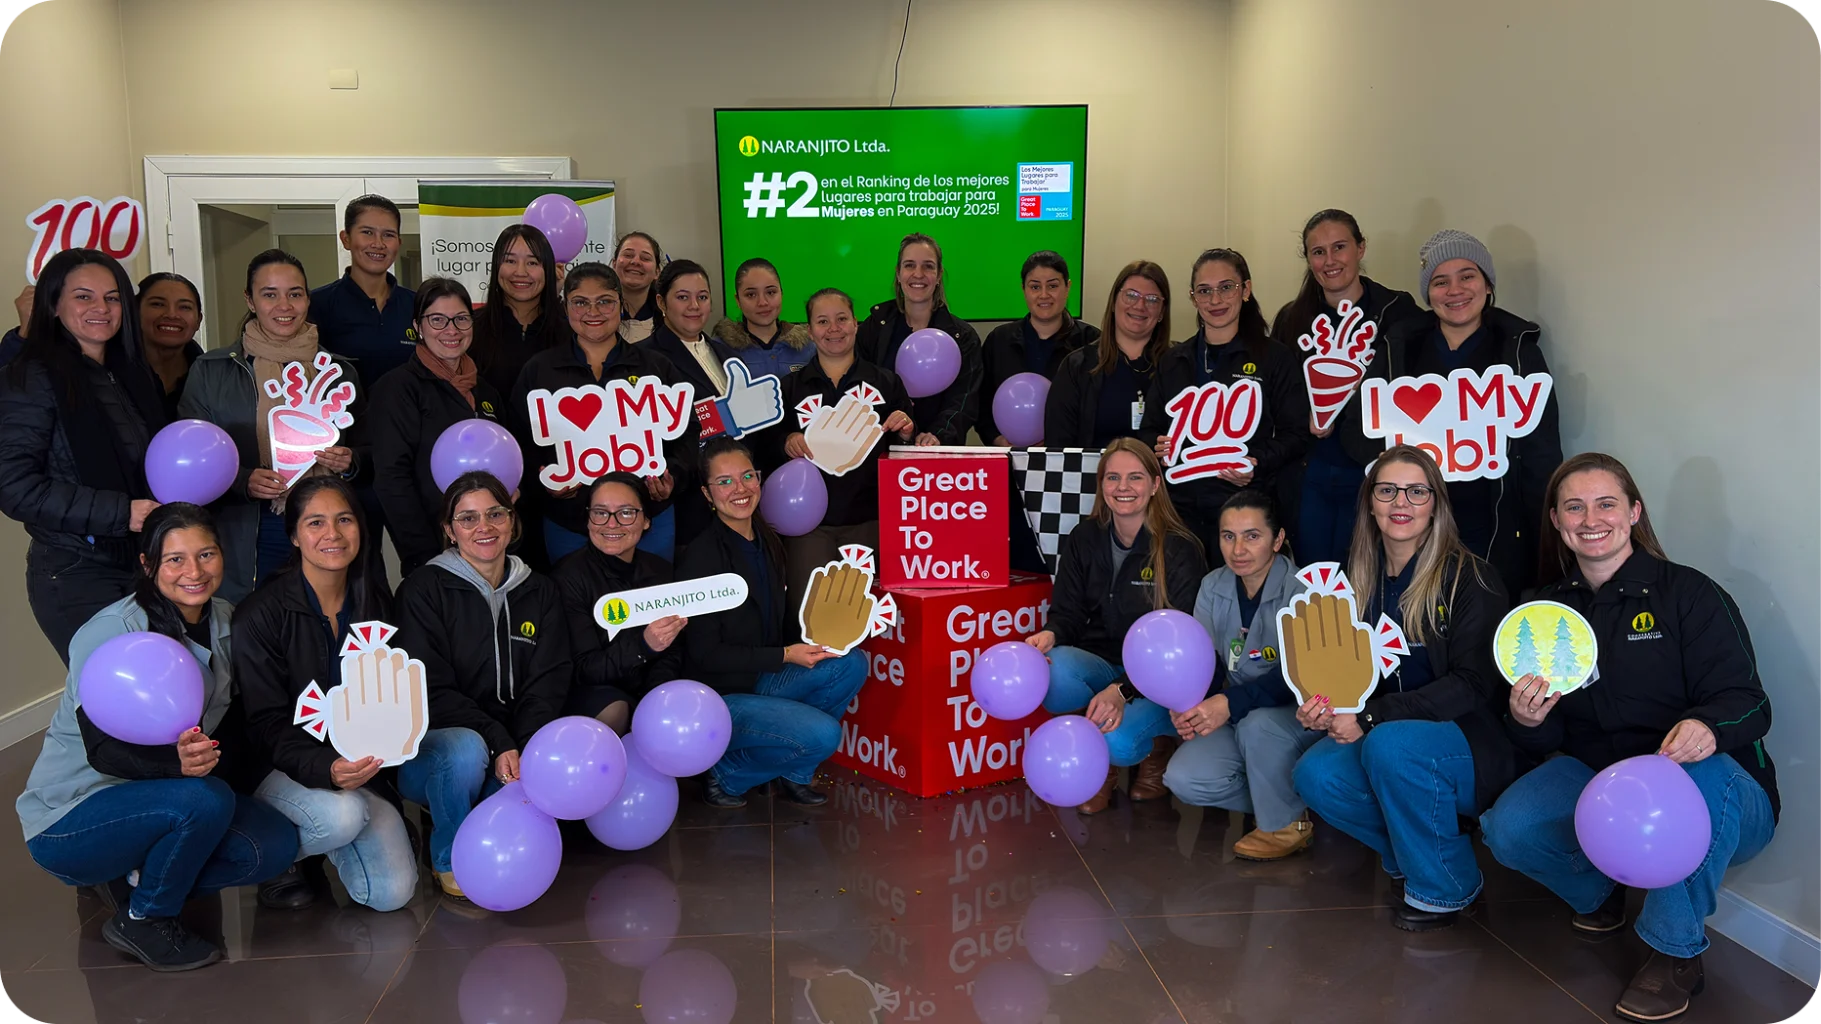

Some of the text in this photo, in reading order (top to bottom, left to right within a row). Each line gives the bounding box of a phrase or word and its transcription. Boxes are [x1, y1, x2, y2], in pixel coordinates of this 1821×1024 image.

[762, 139, 890, 156] NARANJITO Ltda.
[743, 170, 820, 218] #2
[820, 174, 1010, 190] en el Ranking de los mejores
[822, 189, 996, 205] lugares para trabajar para
[822, 202, 1000, 220] Mujeres en Paraguay 2025!
[33, 201, 139, 280] 100
[438, 259, 478, 276] lugar
[536, 384, 686, 438] I My
[1370, 373, 1542, 430] I My
[1170, 384, 1256, 462] 100
[549, 430, 658, 482] Job!
[1395, 424, 1499, 473] ob!
[898, 466, 988, 492] Great
[900, 496, 988, 520] Place
[898, 526, 934, 550] To
[634, 586, 740, 613] NARANJITO Ltda.
[946, 598, 1050, 642] Great
[946, 694, 988, 731] To
